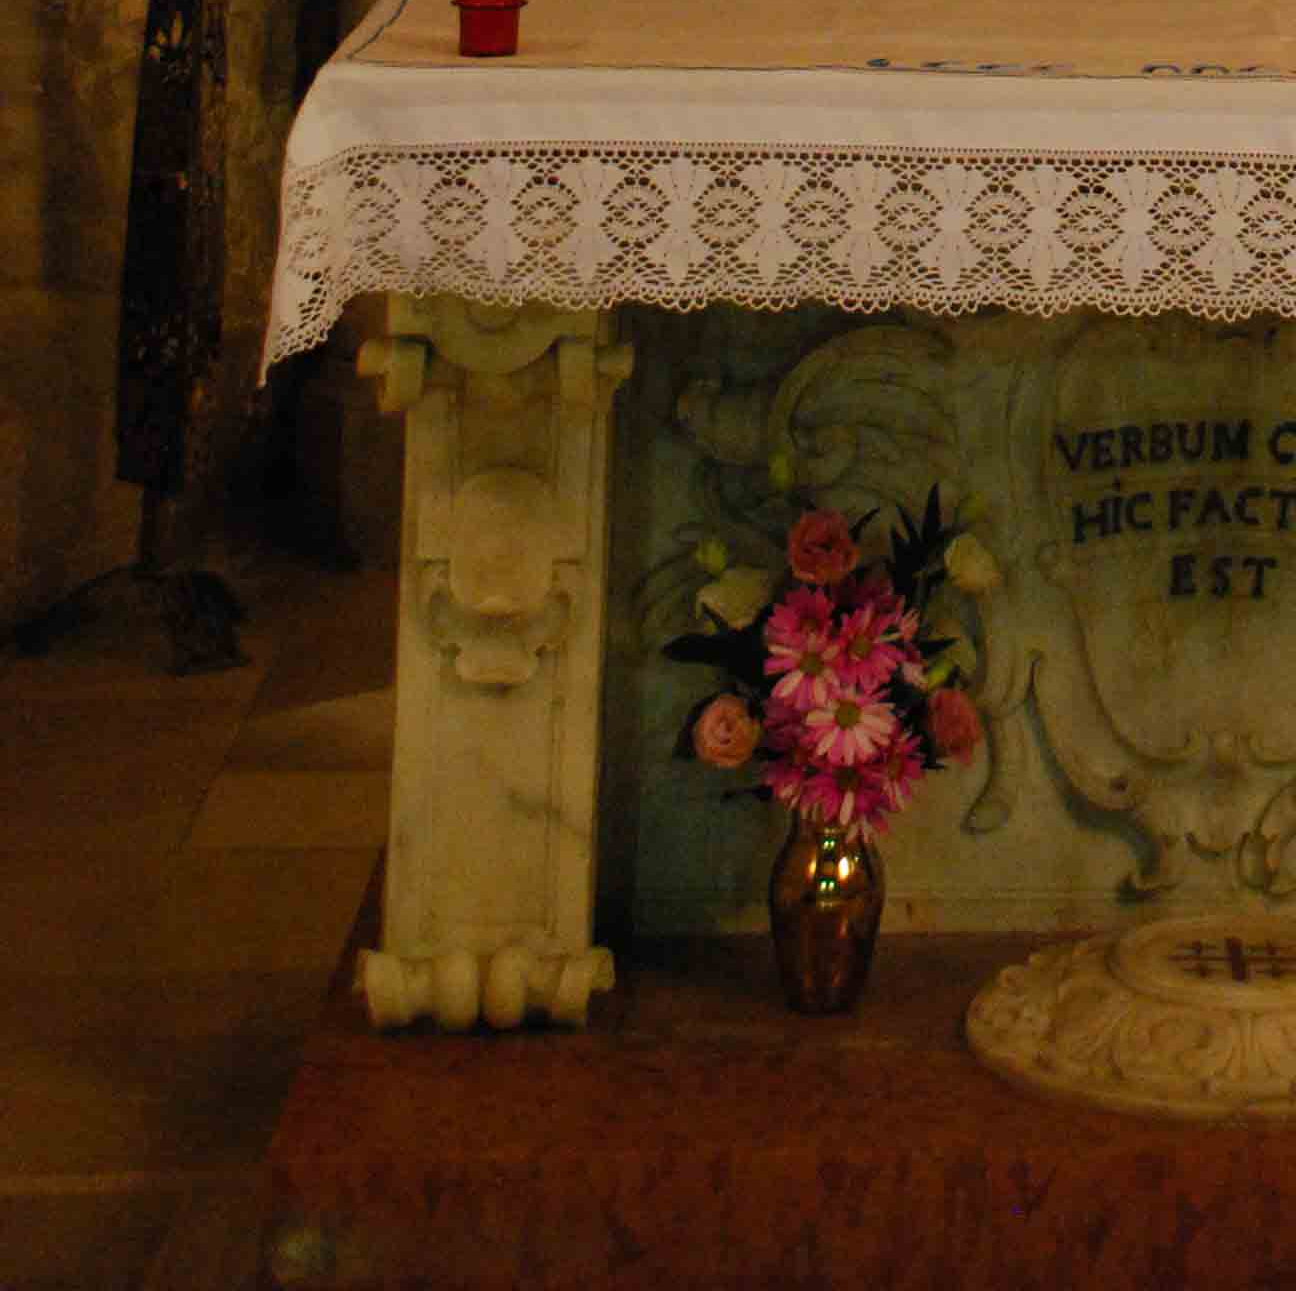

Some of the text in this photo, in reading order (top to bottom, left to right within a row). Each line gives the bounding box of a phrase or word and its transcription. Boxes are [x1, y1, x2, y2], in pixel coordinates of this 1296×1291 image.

[1054, 420, 1251, 473] VERBUM
[1072, 485, 1153, 544] HIC
[1167, 555, 1277, 599] EST
